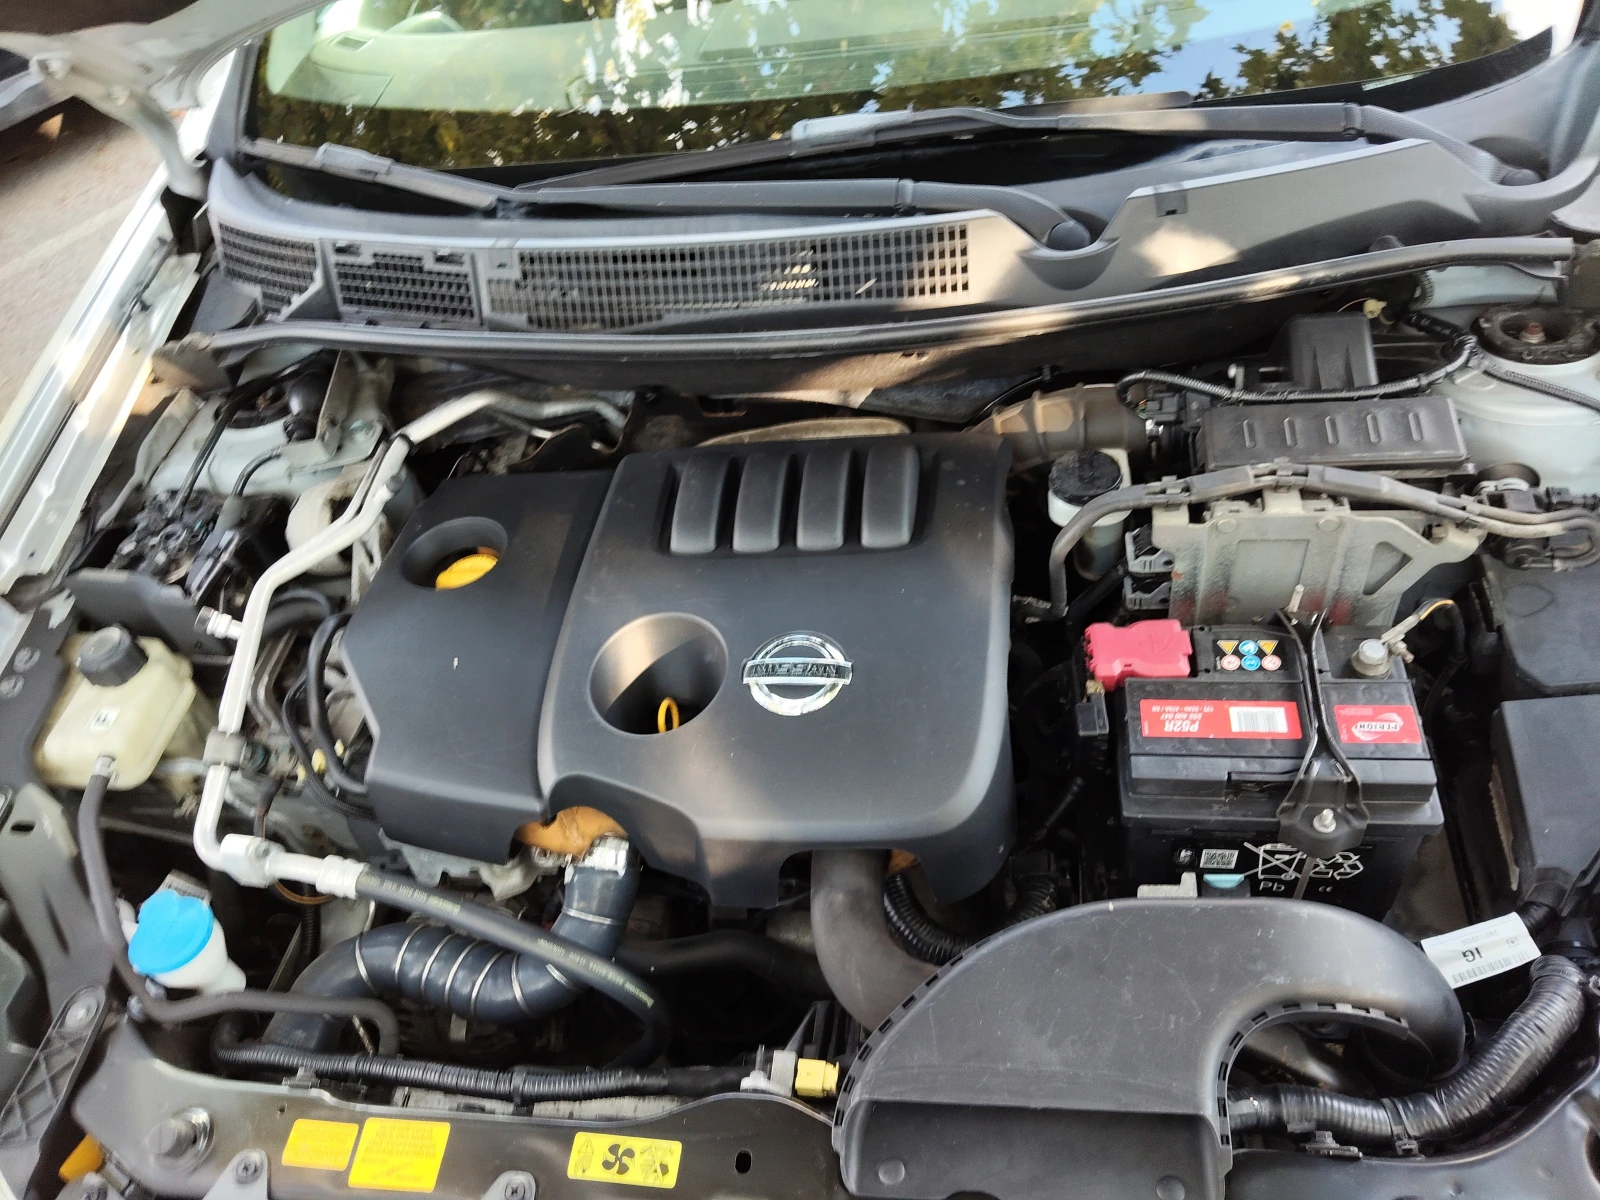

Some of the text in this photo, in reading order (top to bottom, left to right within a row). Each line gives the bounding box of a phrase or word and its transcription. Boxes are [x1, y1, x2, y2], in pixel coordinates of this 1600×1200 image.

[750, 662, 838, 678] NISSAN
[1164, 720, 1199, 732] P52R
[1258, 880, 1285, 892] Pb
[1462, 947, 1483, 963] IG
